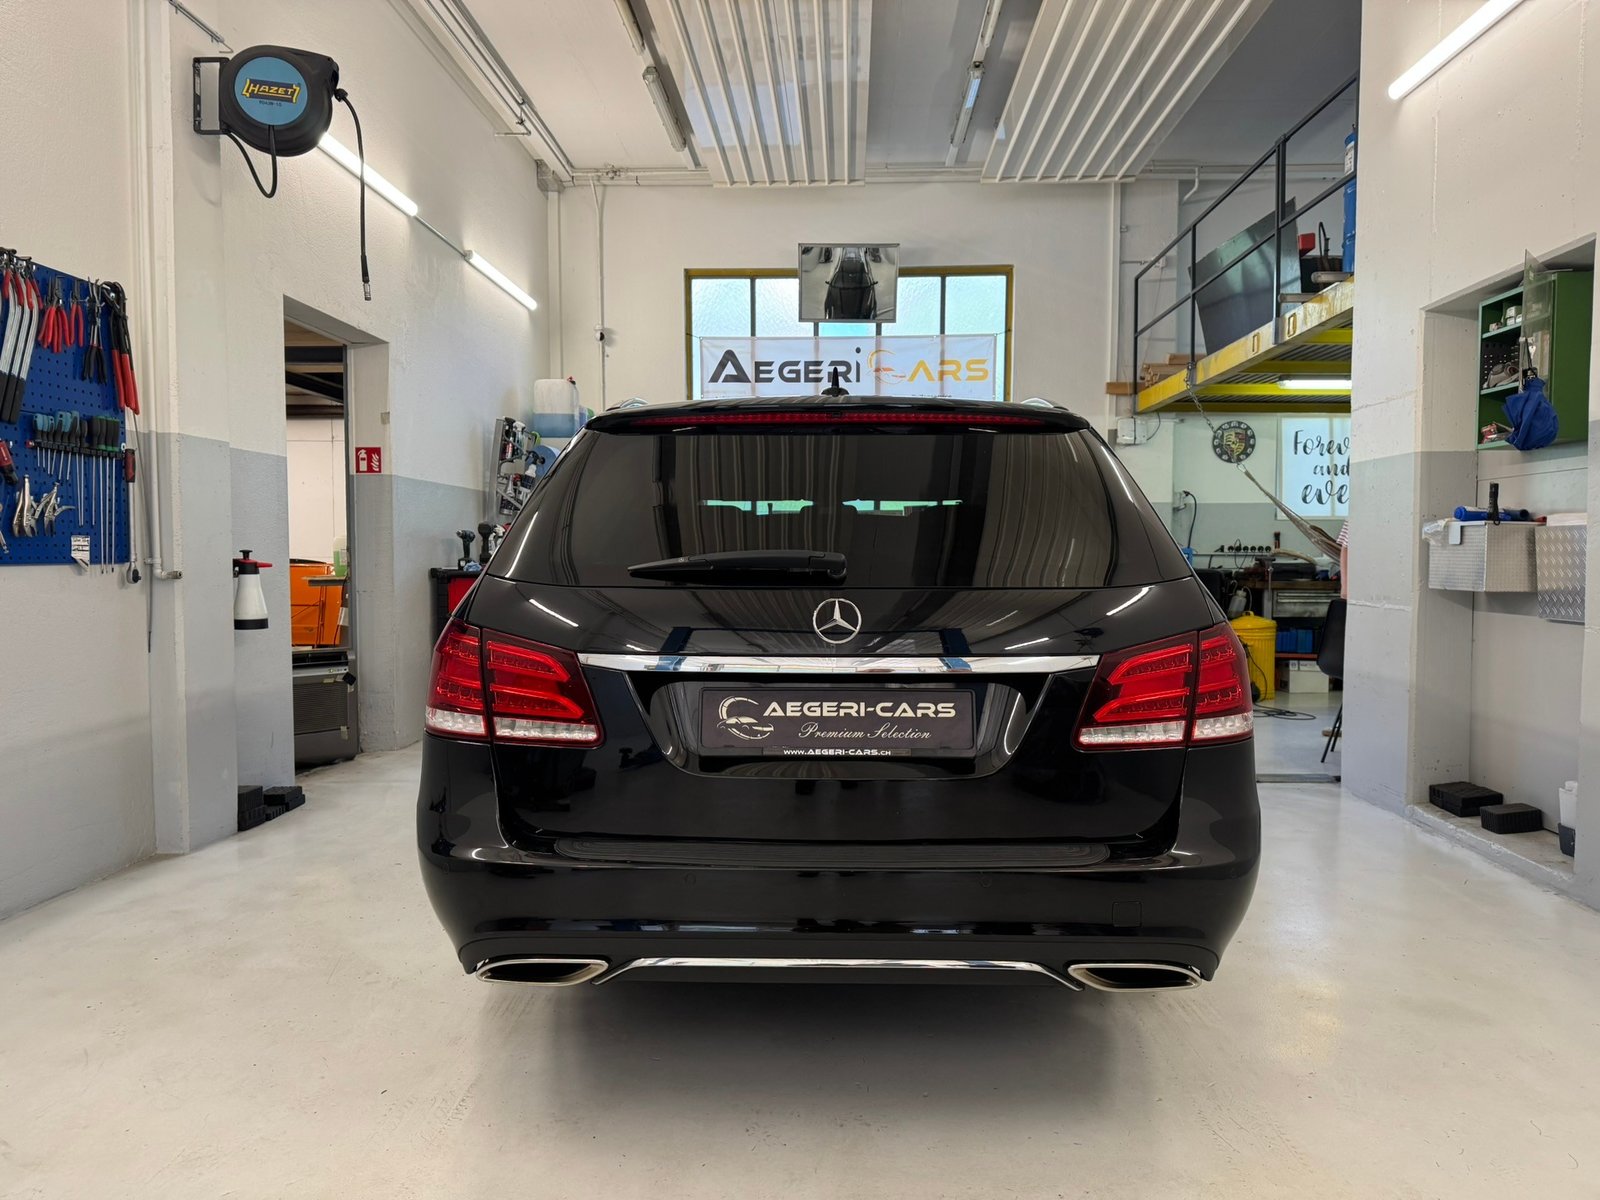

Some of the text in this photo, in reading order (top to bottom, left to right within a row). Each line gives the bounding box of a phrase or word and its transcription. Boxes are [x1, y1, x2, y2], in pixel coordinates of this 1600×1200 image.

[248, 83, 294, 96] HAZET
[763, 701, 956, 718] AEGERI-CARS
[798, 721, 932, 739] Premium Selection
